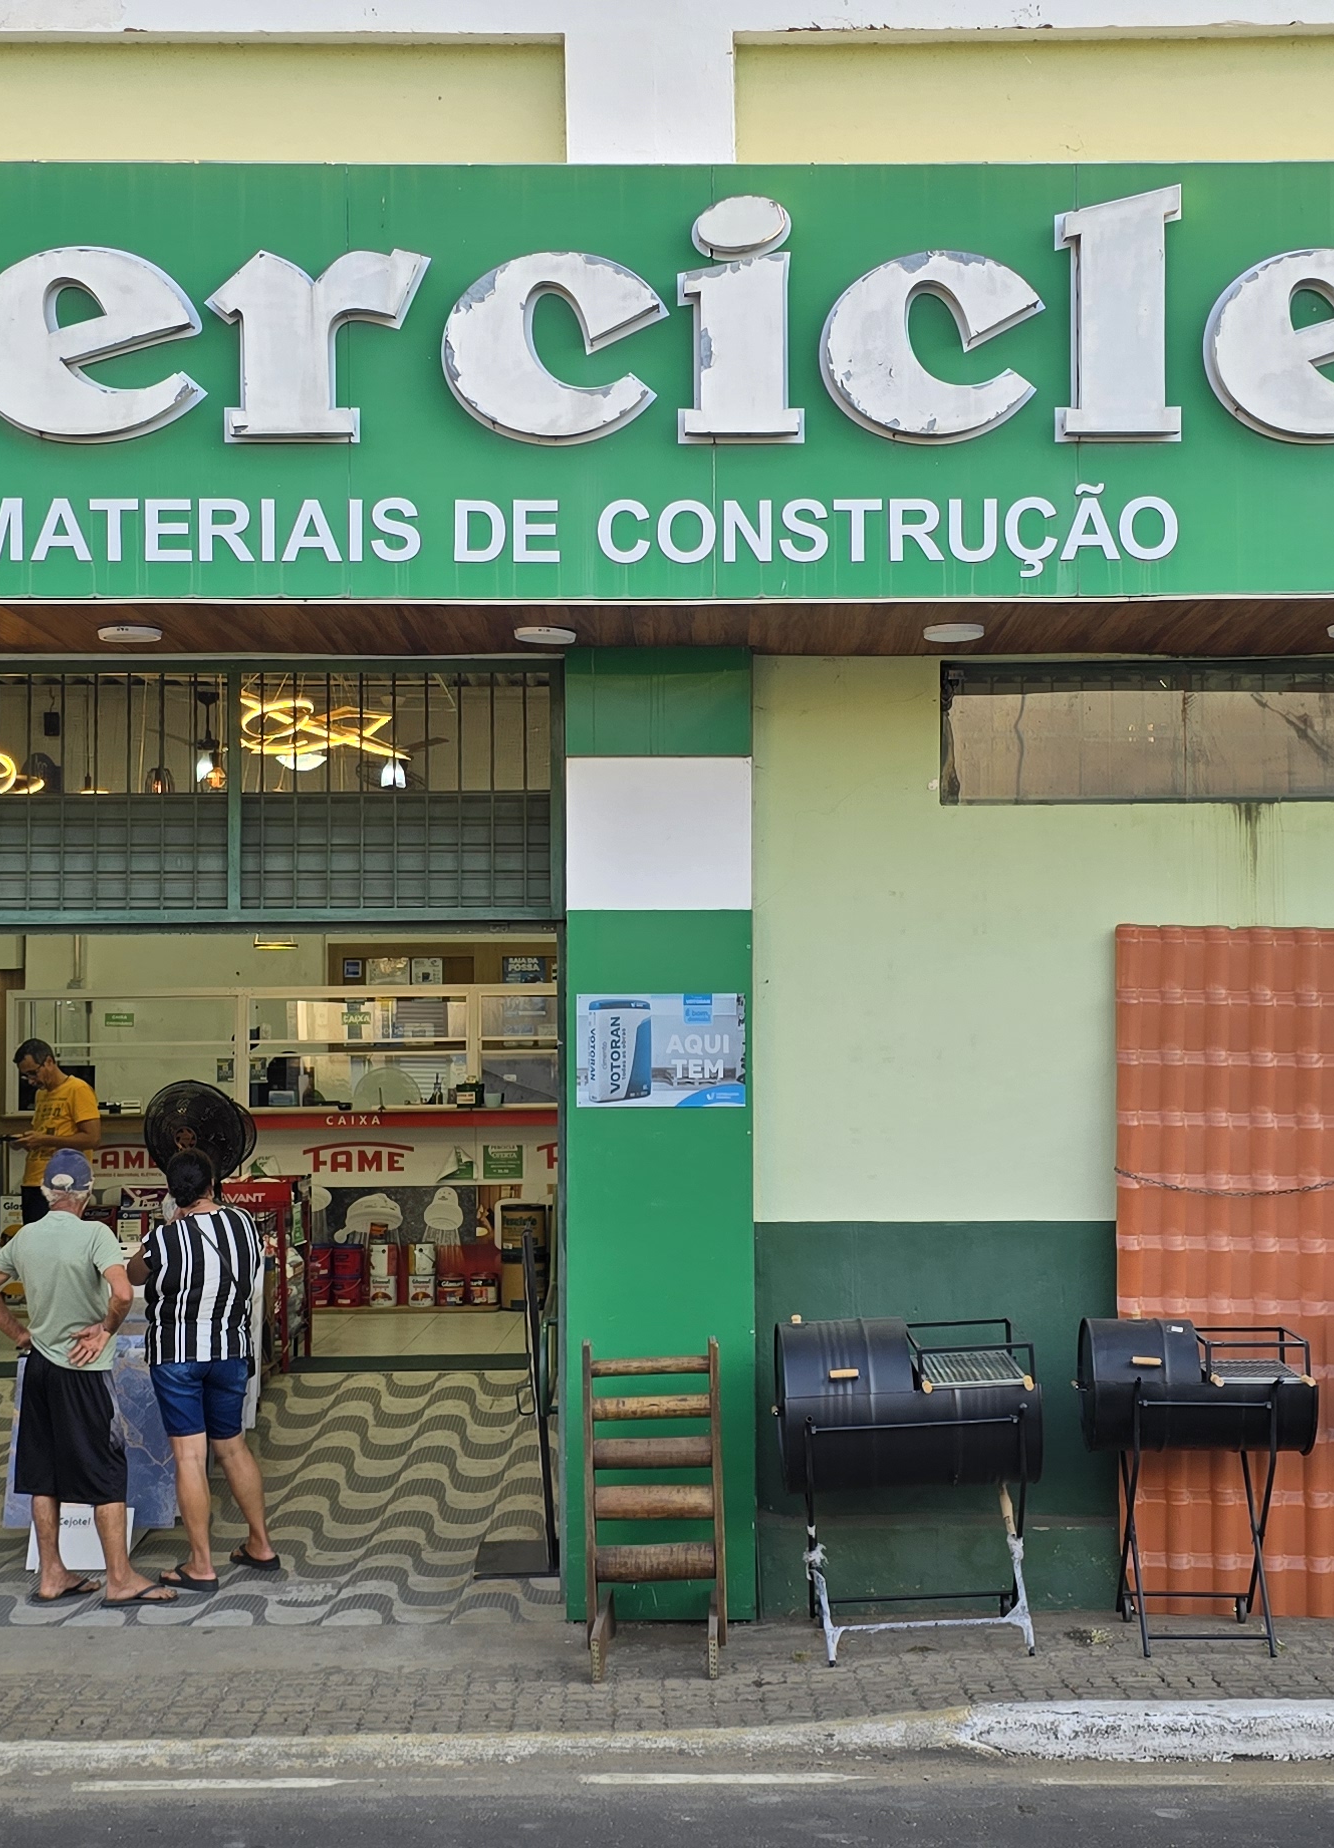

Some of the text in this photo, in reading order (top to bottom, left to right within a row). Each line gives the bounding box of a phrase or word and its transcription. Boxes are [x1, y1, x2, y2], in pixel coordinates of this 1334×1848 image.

[453, 499, 561, 563] DE
[597, 482, 1179, 578] CONSTRUÇÃO
[343, 1014, 370, 1023] CAIXA
[610, 1016, 621, 1094] VOTORAN
[666, 1034, 730, 1056] AQUI
[670, 1059, 724, 1079] TEM
[325, 1115, 381, 1126] CAIXA
[302, 1141, 414, 1173] FAME
